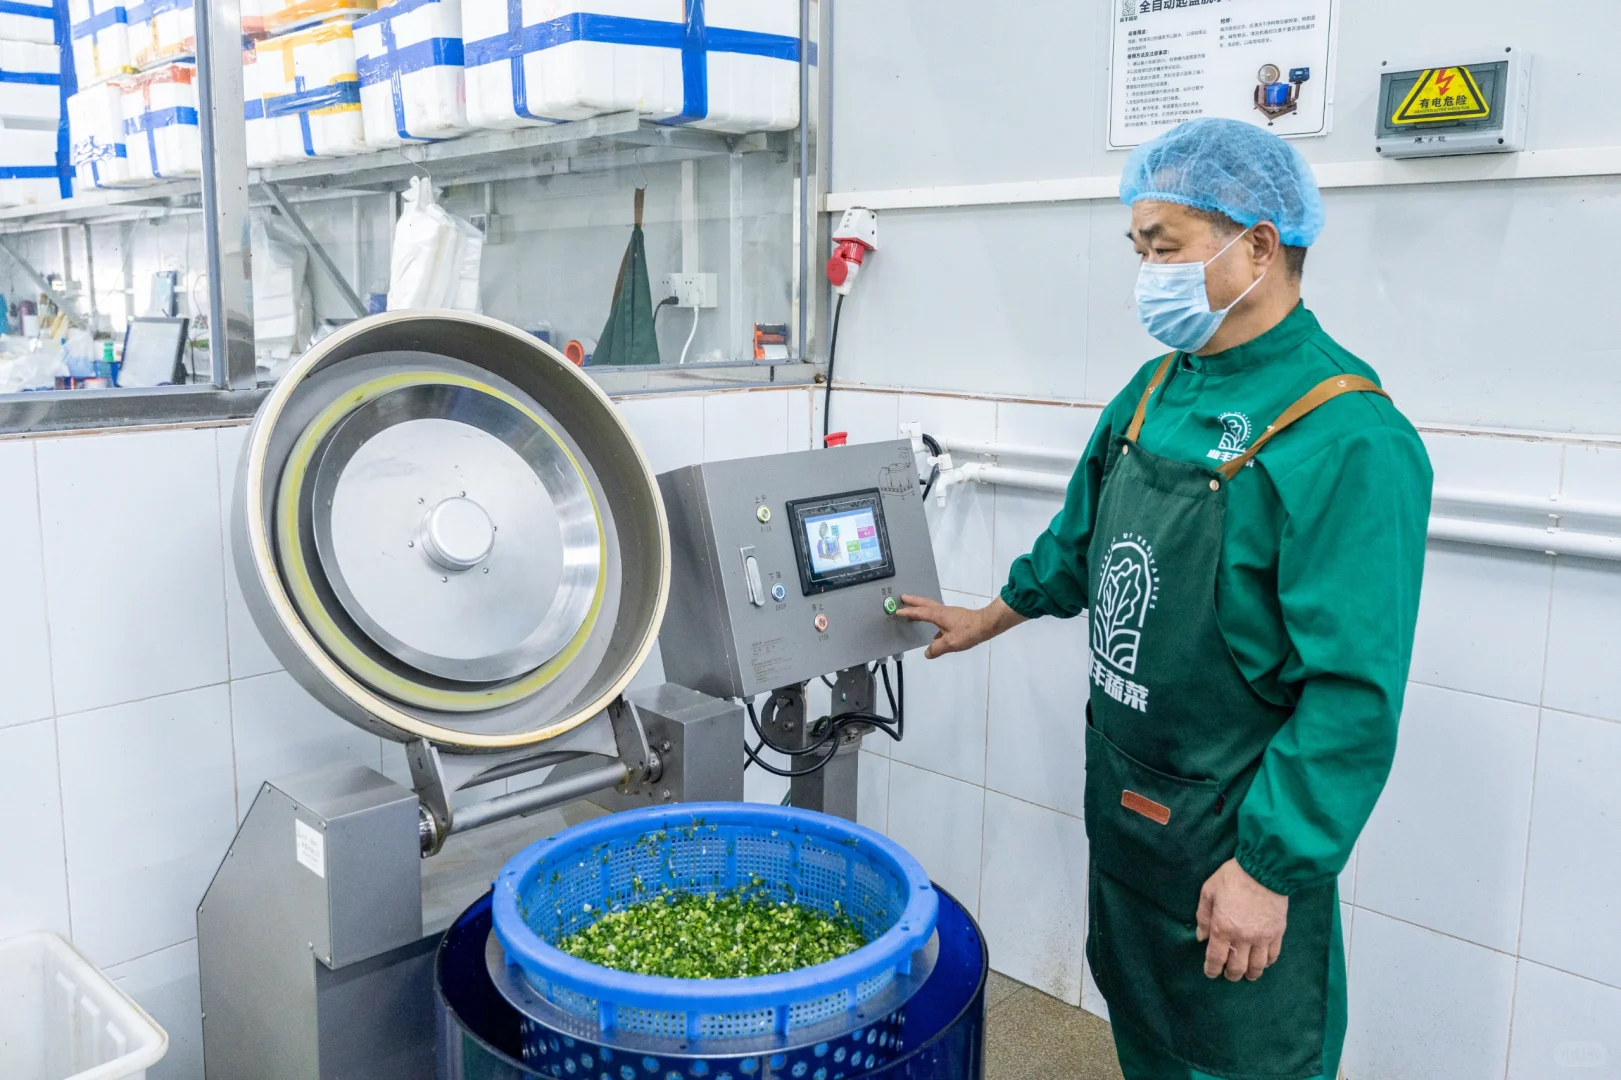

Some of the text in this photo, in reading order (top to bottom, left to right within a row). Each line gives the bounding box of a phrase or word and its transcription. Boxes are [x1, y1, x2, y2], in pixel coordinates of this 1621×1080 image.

[1419, 95, 1467, 109] 有电危险
[1089, 647, 1149, 713] 丰蔬菜
